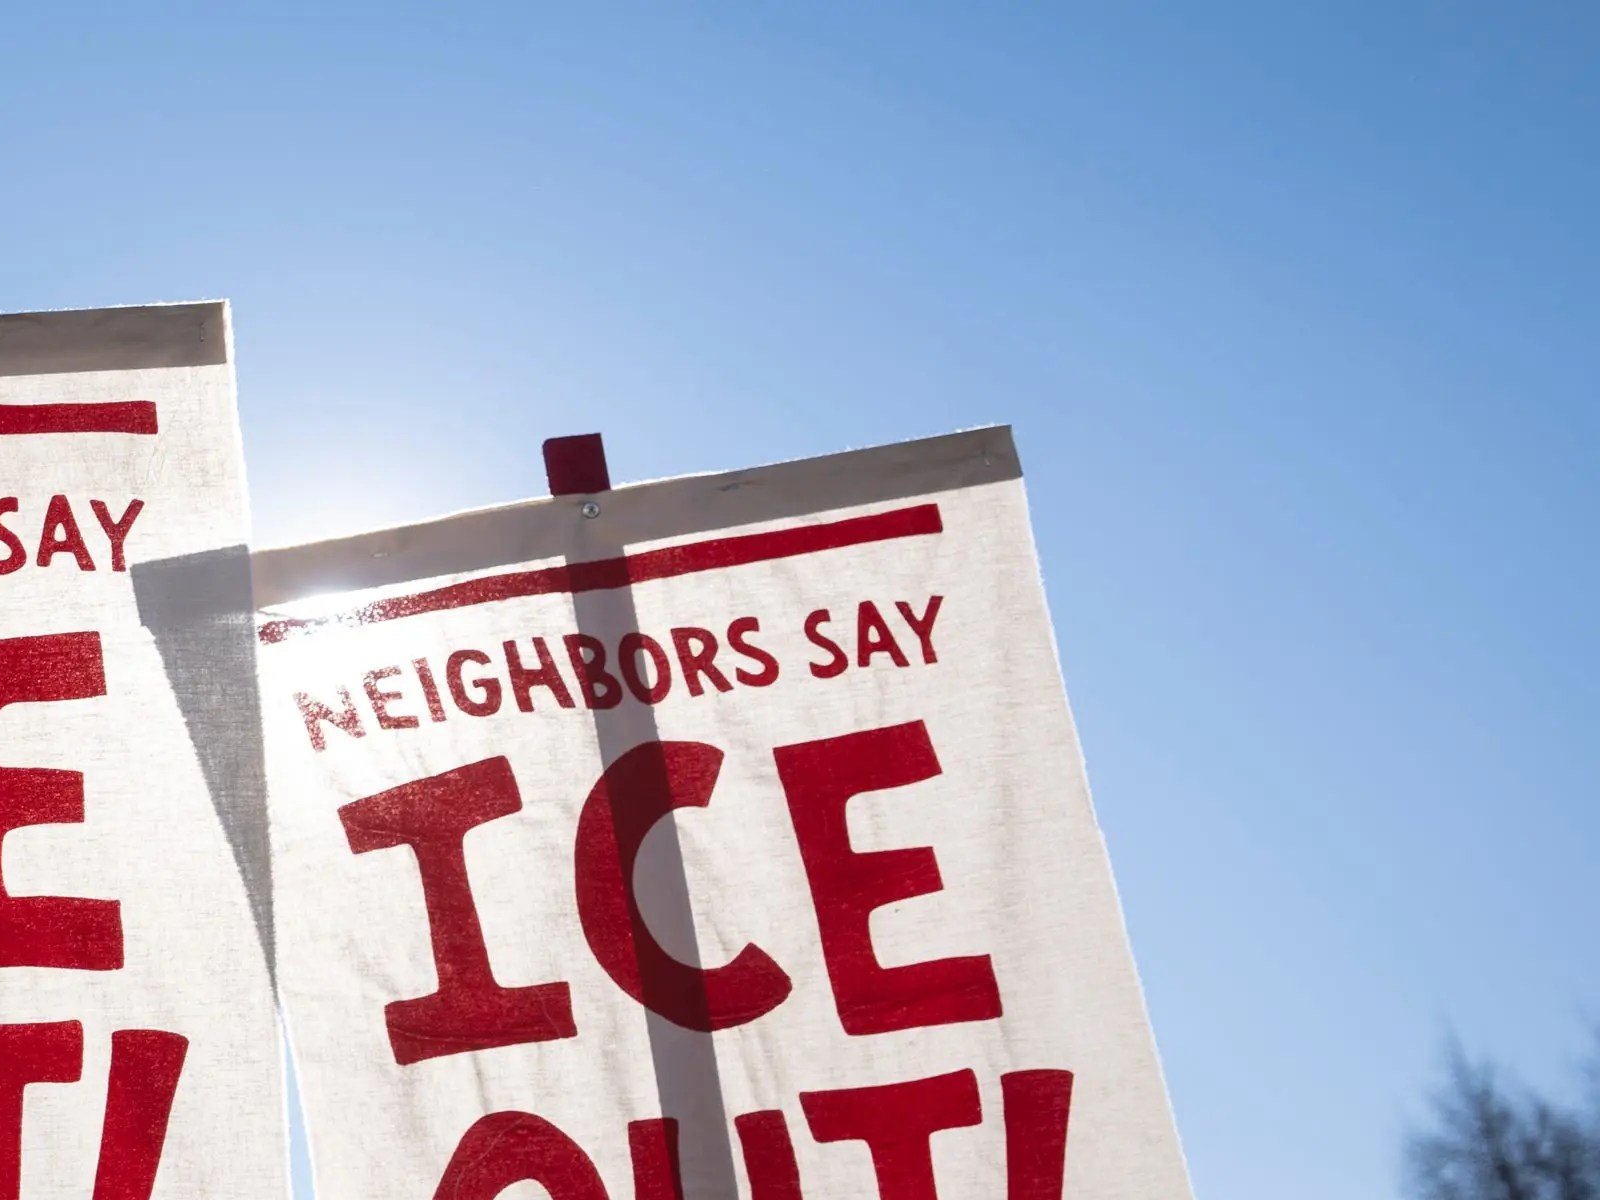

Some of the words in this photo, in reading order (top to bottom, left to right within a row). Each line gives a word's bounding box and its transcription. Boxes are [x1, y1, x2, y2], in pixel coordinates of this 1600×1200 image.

[294, 617, 779, 752] NEIGHBORS
[804, 596, 943, 679] SAY
[339, 720, 1003, 1066] ICE
